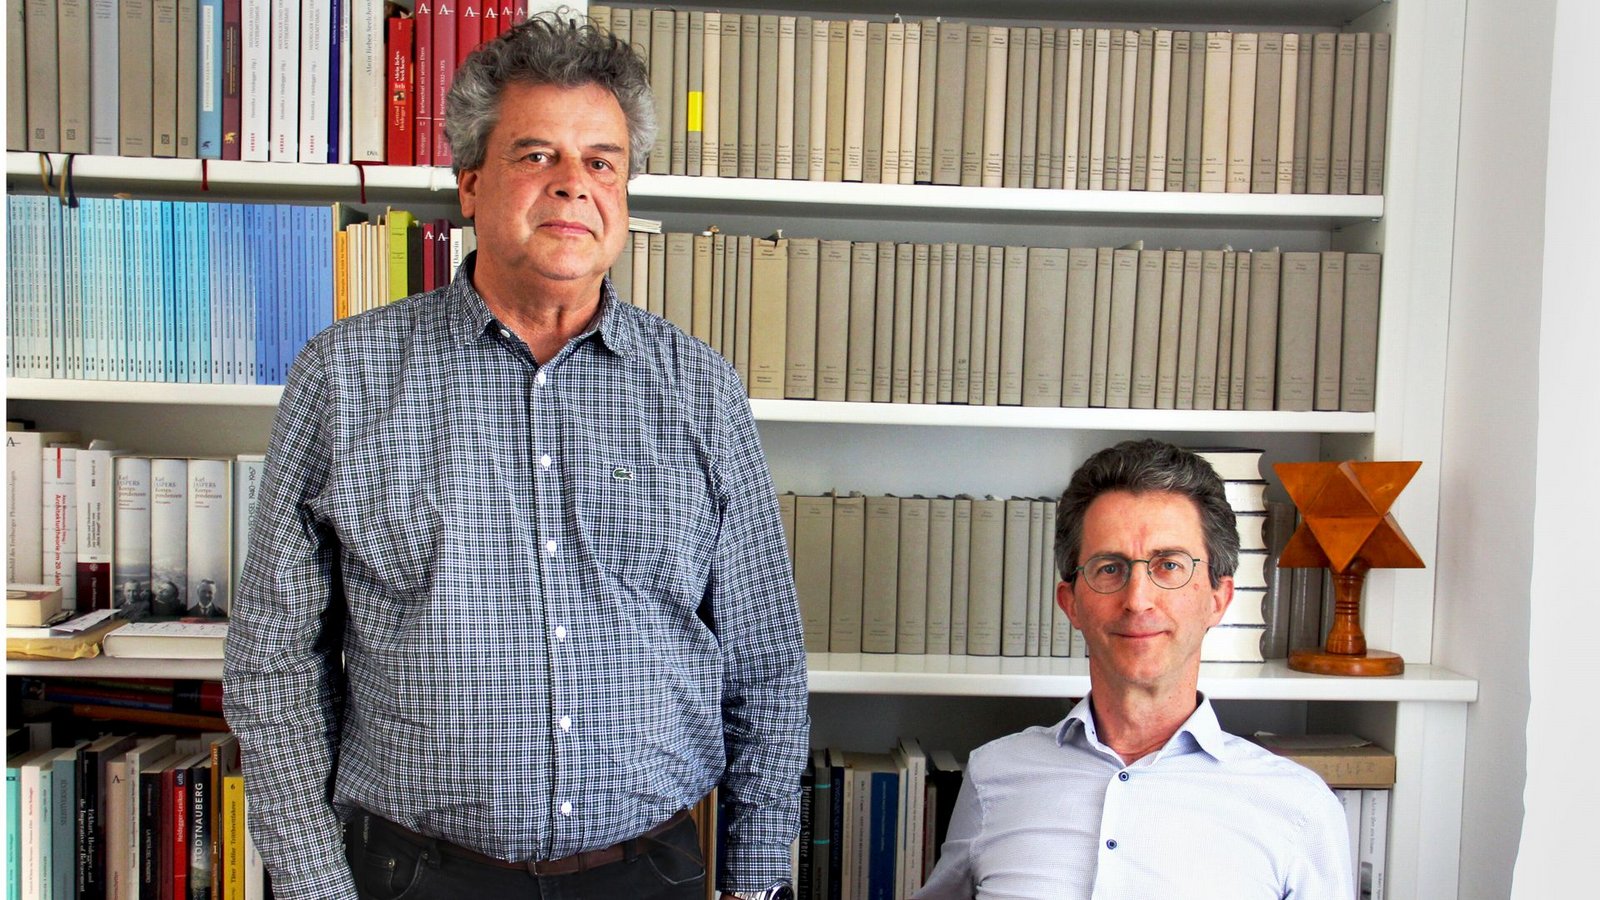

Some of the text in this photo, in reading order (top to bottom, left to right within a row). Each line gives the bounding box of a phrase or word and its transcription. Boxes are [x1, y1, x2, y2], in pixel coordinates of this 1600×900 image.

[419, 132, 427, 156] Heidegger
[452, 240, 460, 264] Dasein
[87, 808, 95, 835] Eckhart,
[177, 790, 185, 842] Heidegger-Lexikon
[195, 782, 204, 861] TODTNAUBERG
[802, 785, 813, 829] Heidegger's
[78, 810, 86, 844] Imperative
[801, 831, 812, 857] Silence
